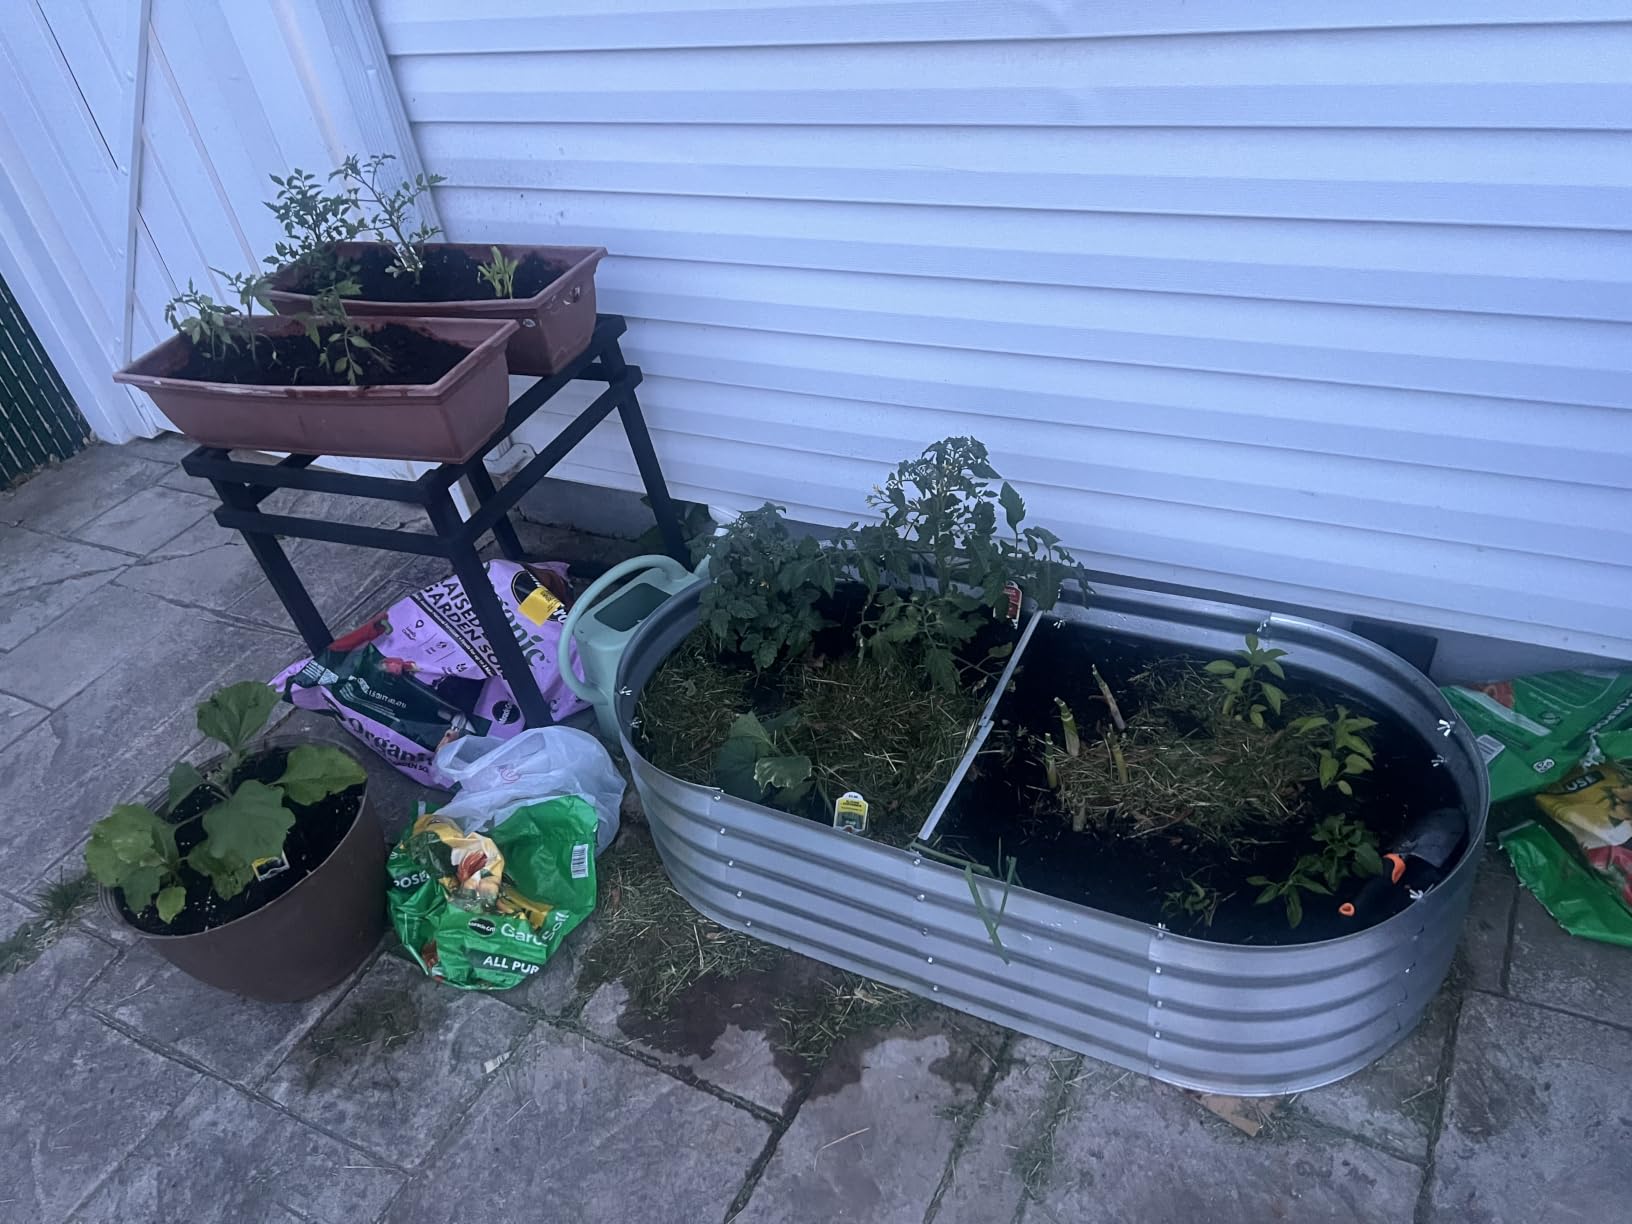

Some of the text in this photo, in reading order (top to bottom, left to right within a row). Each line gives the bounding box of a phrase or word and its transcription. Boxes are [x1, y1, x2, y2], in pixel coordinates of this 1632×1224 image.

[440, 581, 481, 628] AISED
[478, 644, 503, 672] SO
[348, 718, 434, 766] Organi
[1566, 774, 1597, 791] USE
[542, 911, 570, 941] Soil
[483, 955, 509, 969] ALL
